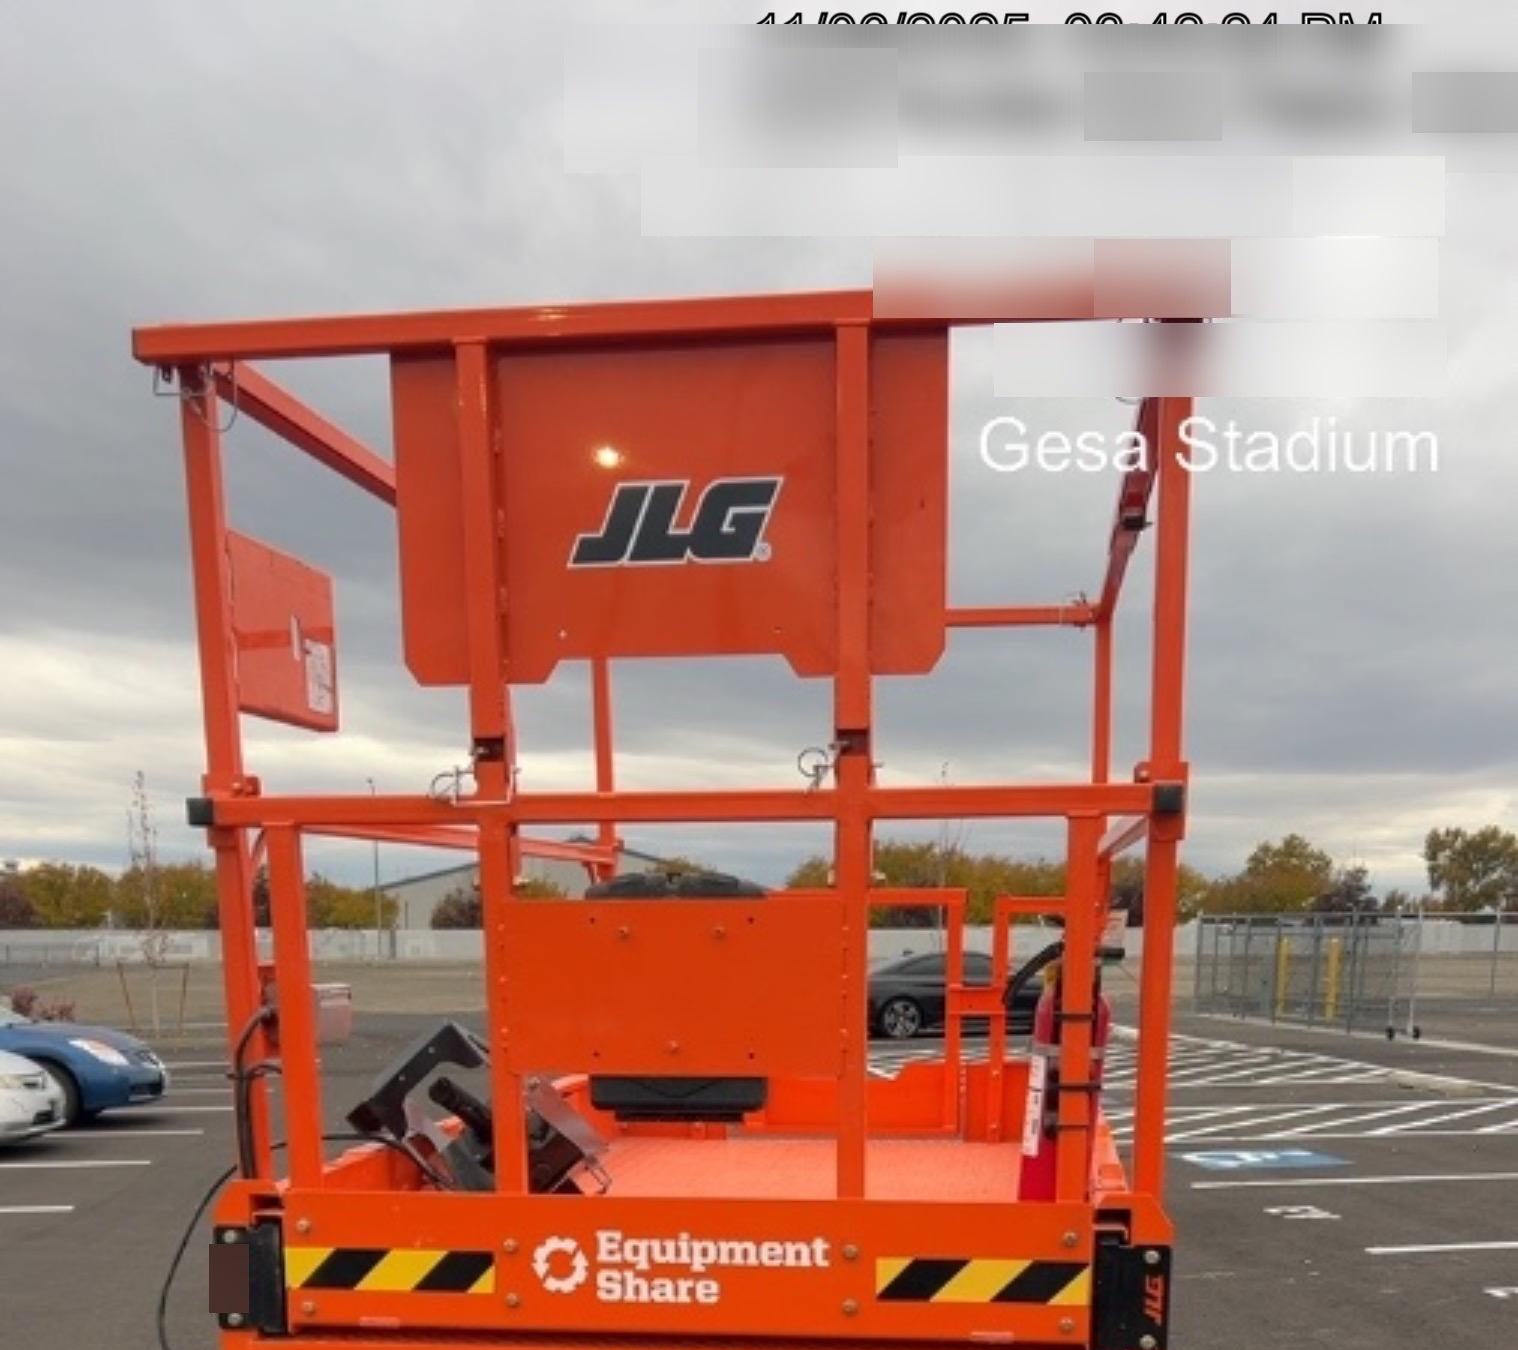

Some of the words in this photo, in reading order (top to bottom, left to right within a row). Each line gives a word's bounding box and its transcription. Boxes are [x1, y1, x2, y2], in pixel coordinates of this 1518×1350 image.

[596, 1230, 830, 1273] Equipment
[596, 1269, 720, 1304] Share
[1144, 1274, 1164, 1327] JLG
